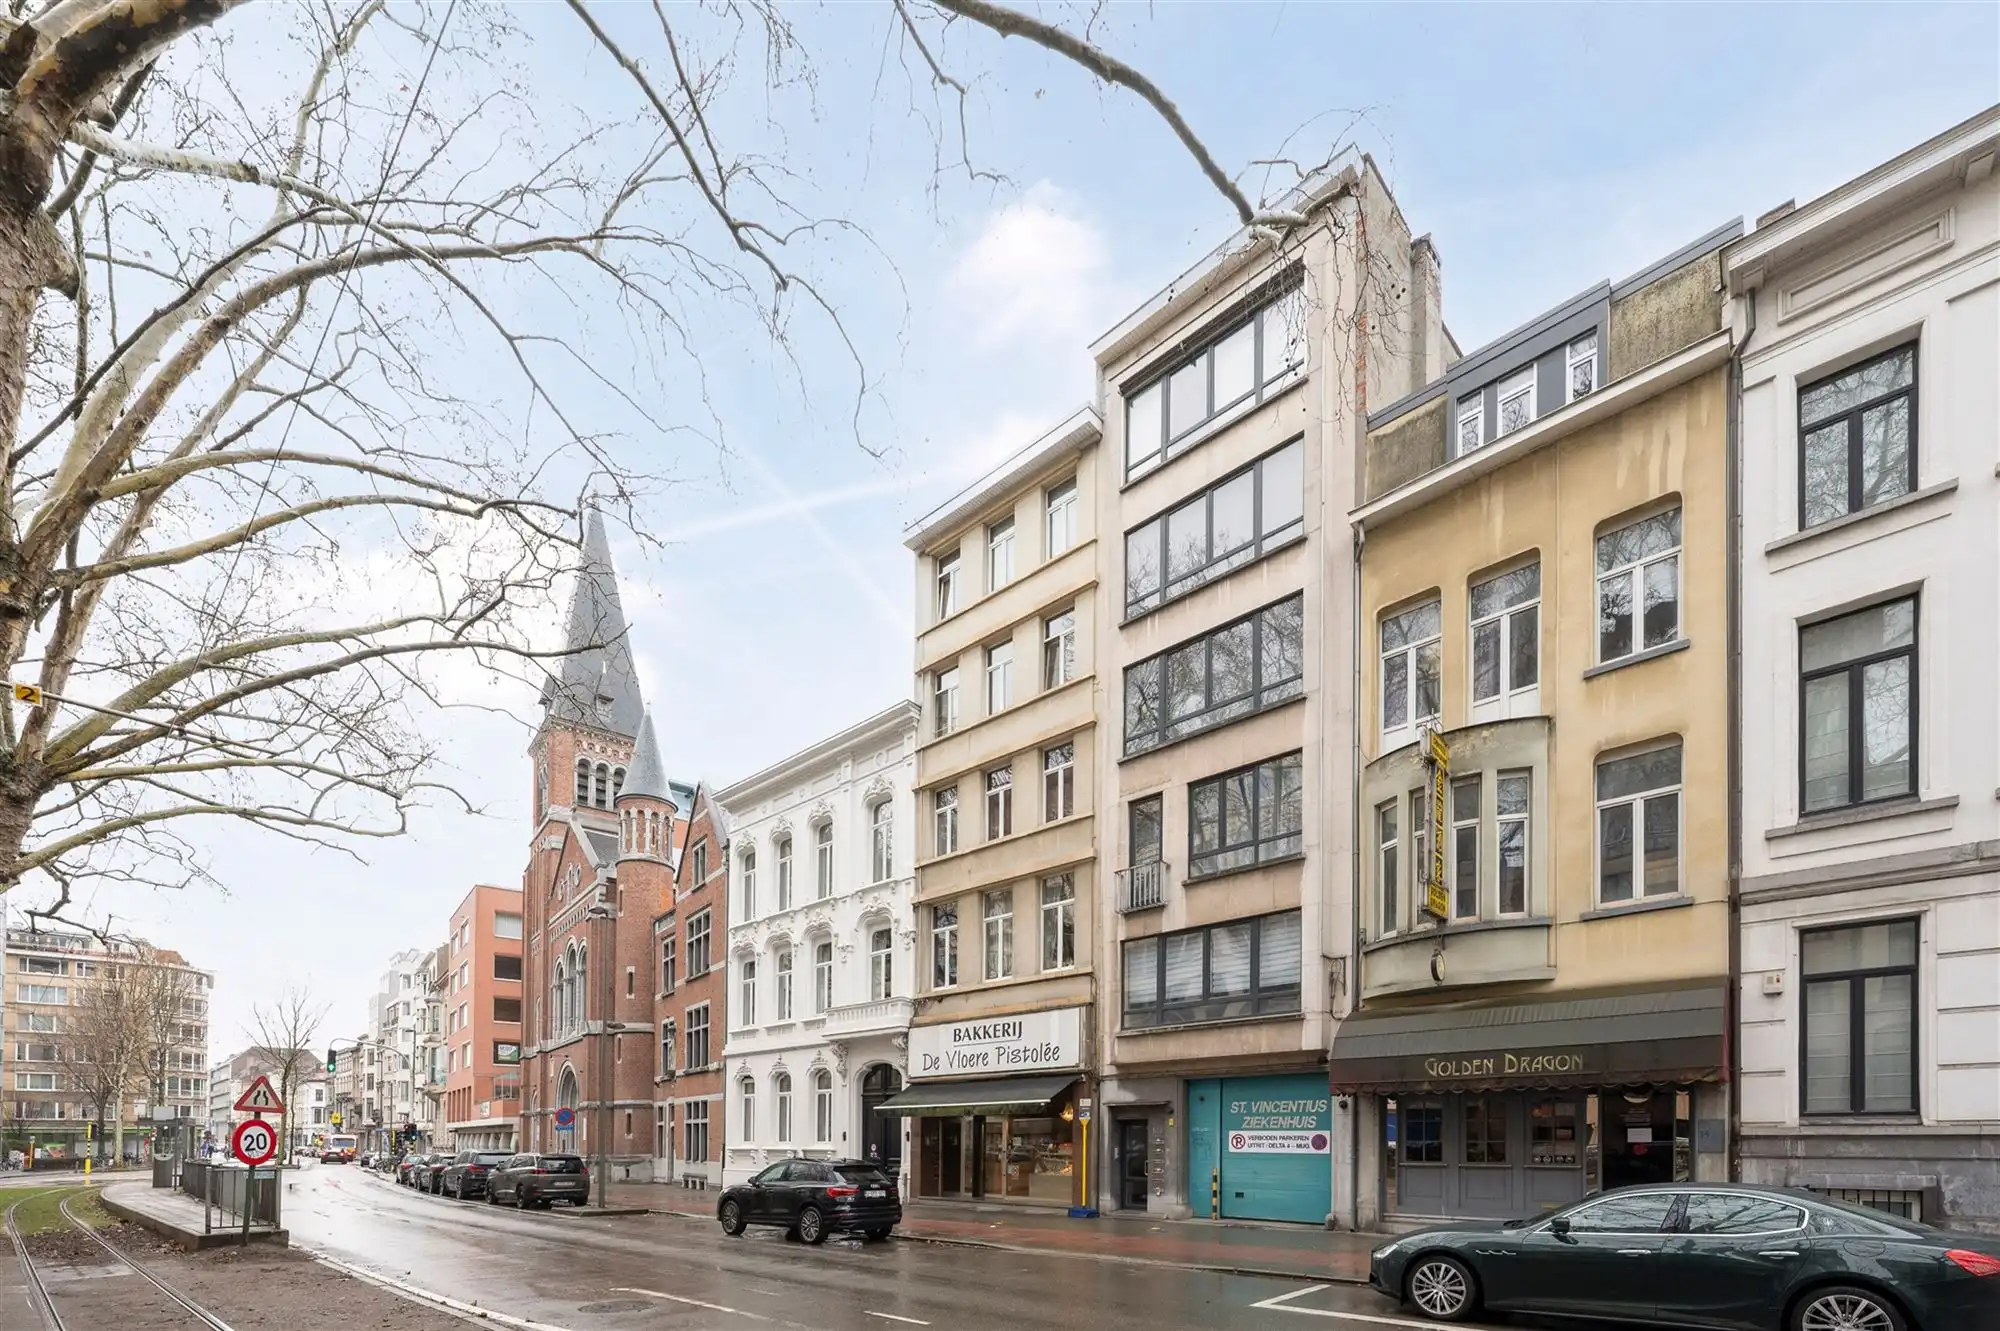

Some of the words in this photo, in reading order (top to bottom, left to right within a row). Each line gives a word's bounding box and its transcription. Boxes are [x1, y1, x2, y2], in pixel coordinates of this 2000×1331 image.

[20, 686, 36, 702] 2
[953, 1021, 1022, 1042] BAKKERIJ
[922, 1053, 940, 1071] De
[946, 1050, 989, 1069] Vloere
[995, 1042, 1060, 1065] Pistolée
[1425, 1058, 1494, 1077] GOLDEN
[1504, 1053, 1583, 1073] DRAGON
[1230, 1101, 1247, 1113] ST.
[1251, 1100, 1328, 1113] VINCENTIUS
[1241, 1115, 1317, 1129] ZIEKENHUIS
[244, 1133, 267, 1151] 20
